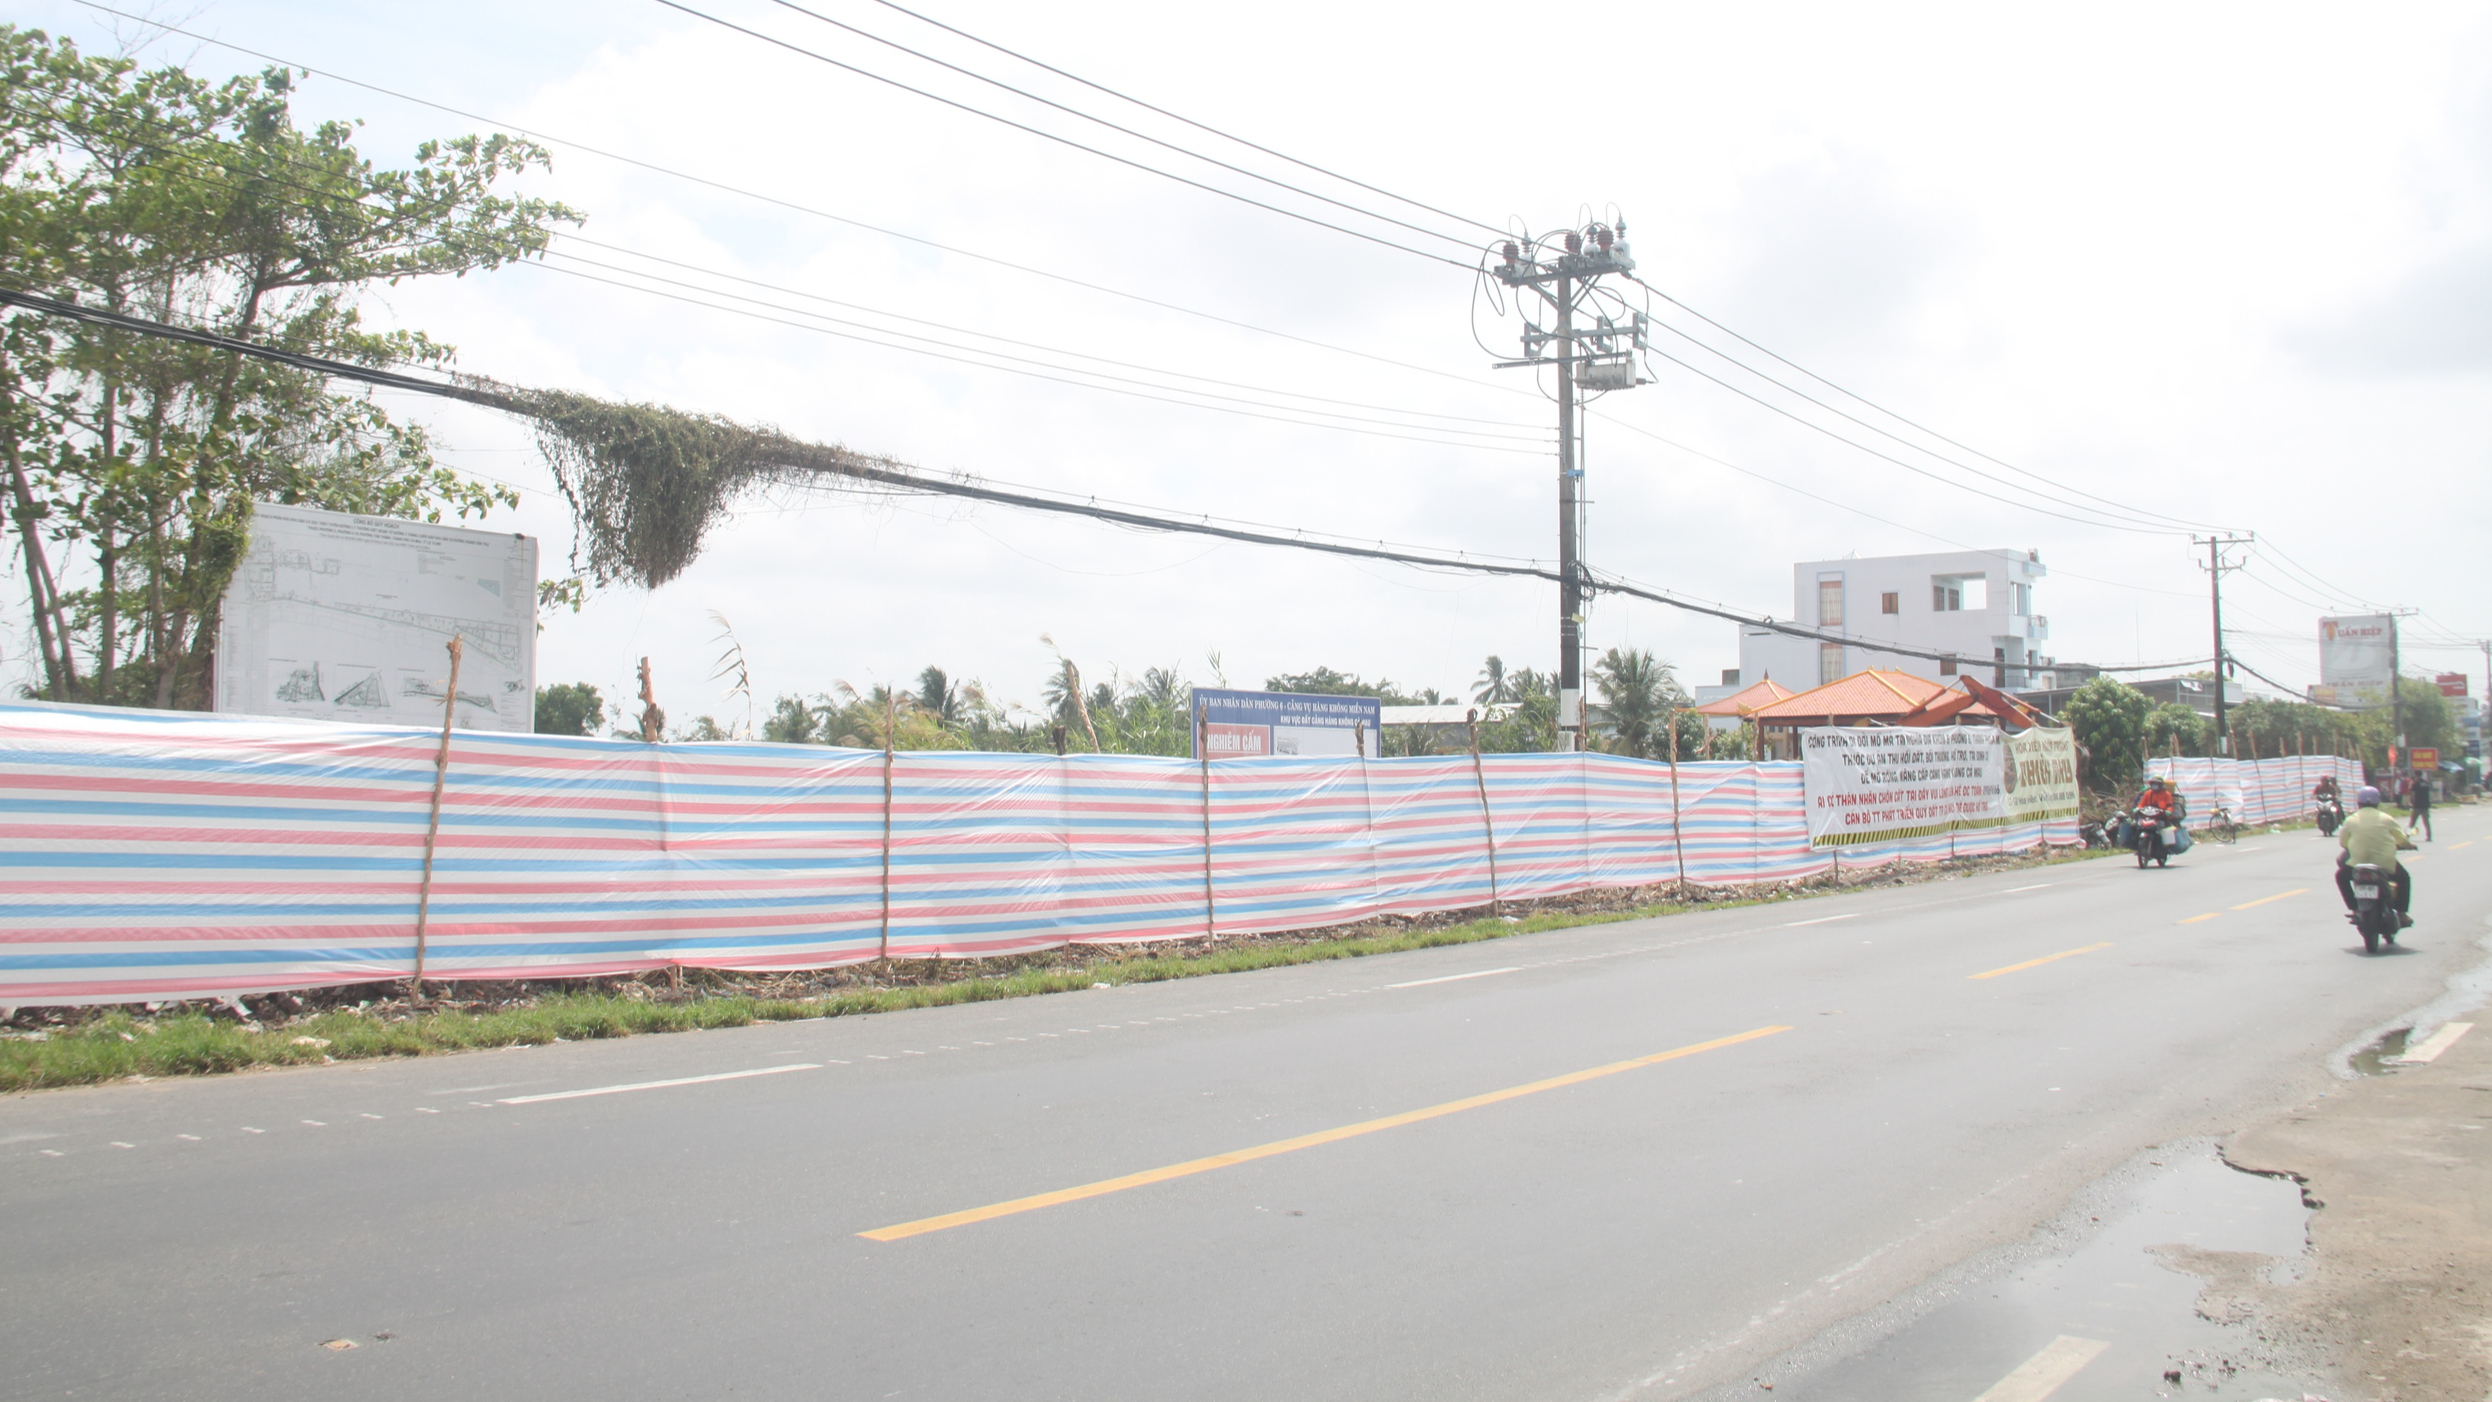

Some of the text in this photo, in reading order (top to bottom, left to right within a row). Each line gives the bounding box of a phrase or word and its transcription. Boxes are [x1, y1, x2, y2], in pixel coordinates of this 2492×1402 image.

[1200, 694, 1208, 706] ỦY
[1209, 697, 1222, 707] BAN
[1222, 697, 1240, 708] NHÂN
[1241, 698, 1254, 709] DÂN
[1254, 698, 1279, 711] PHƯỜNG
[1280, 702, 1283, 711] 6
[1287, 699, 1303, 711] CẢNG
[1304, 702, 1312, 713] VỤ
[1312, 701, 1328, 712] HÀNG
[1329, 702, 1348, 714] KHÔNG
[1364, 706, 1375, 715] NAM
[1280, 716, 1290, 724] KHU
[1291, 714, 1301, 726] VỰC
[1207, 730, 1261, 750] NGHIÊM CẤM
[1836, 792, 1857, 806] THÂN
[1859, 790, 1877, 805] NHÂN
[1845, 809, 1860, 825] CÁN
[1862, 810, 1871, 826] BỘ
